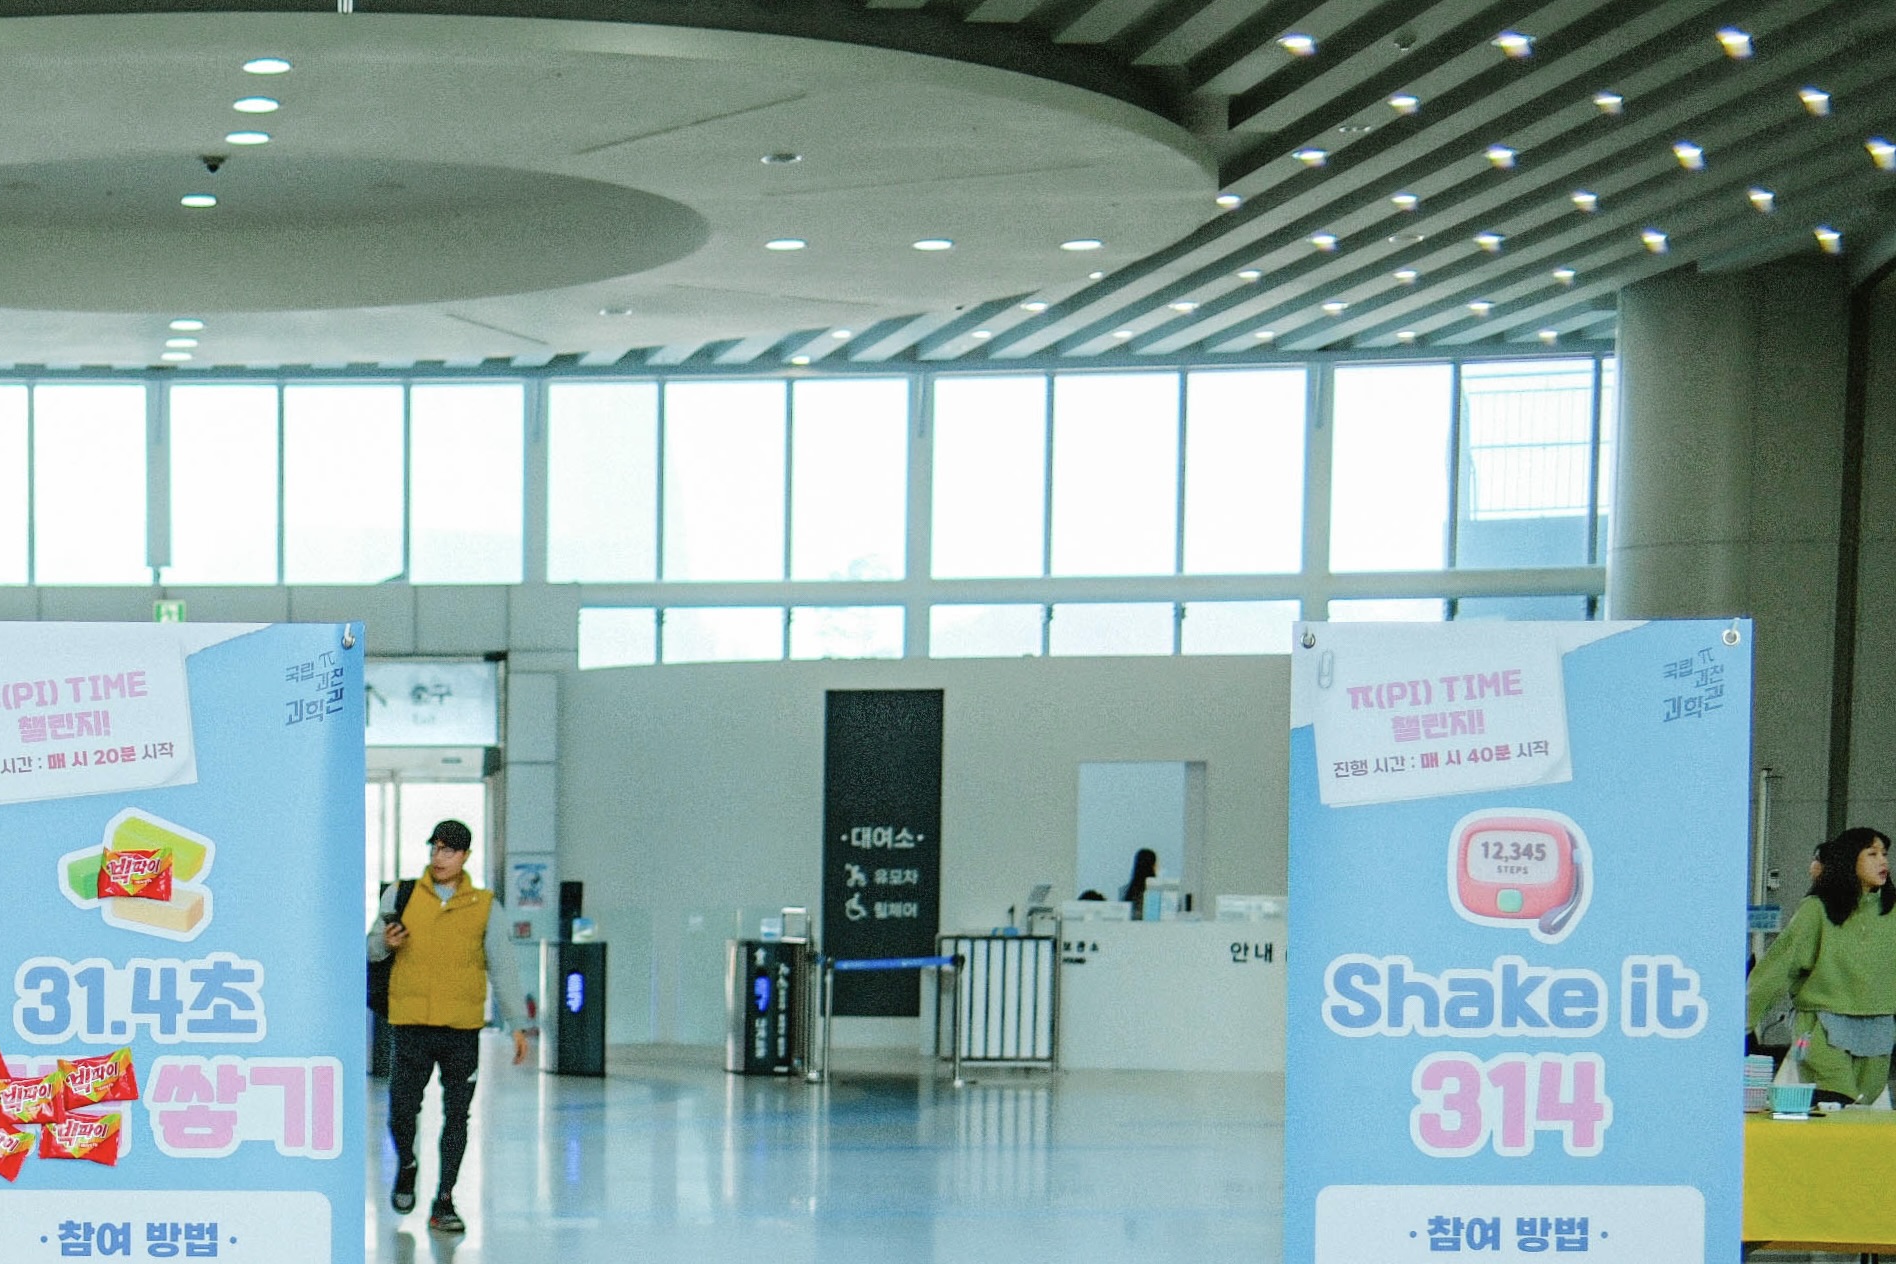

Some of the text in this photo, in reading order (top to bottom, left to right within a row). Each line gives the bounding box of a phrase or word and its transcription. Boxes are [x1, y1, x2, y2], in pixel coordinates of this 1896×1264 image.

[285, 660, 314, 683] 국립
[1663, 657, 1693, 680] 국립
[65, 671, 147, 703] TIME
[1347, 669, 1523, 710] π(PI) TIME
[1663, 684, 1724, 723] 과학관
[285, 687, 344, 726] 과학관
[18, 710, 110, 743] 챌린지!
[1391, 709, 1485, 742] 챌린지!
[1, 757, 32, 774] 시간
[48, 754, 66, 770] 매
[72, 751, 87, 766] 시
[94, 746, 136, 765] 20분
[142, 742, 174, 759] 시작
[1334, 740, 1549, 778] 진행 시간 매 시 40분 시작
[851, 826, 915, 849] 대여소
[1482, 842, 1546, 862] 12,345
[107, 857, 160, 884] 빅파이
[1498, 866, 1528, 874] STEPS
[1230, 942, 1273, 963] 안내
[22, 959, 258, 1036] 31.4초
[1331, 962, 1699, 1029] Shake it
[66, 1061, 120, 1094] 빅파이
[0, 1083, 52, 1112] 빅파이
[153, 1063, 335, 1151] 쌓기
[1419, 1059, 1603, 1148] 314
[53, 1120, 107, 1148] 빅파이
[58, 1221, 217, 1257] 참여 방법
[1428, 1216, 1588, 1252] 참여 방법
